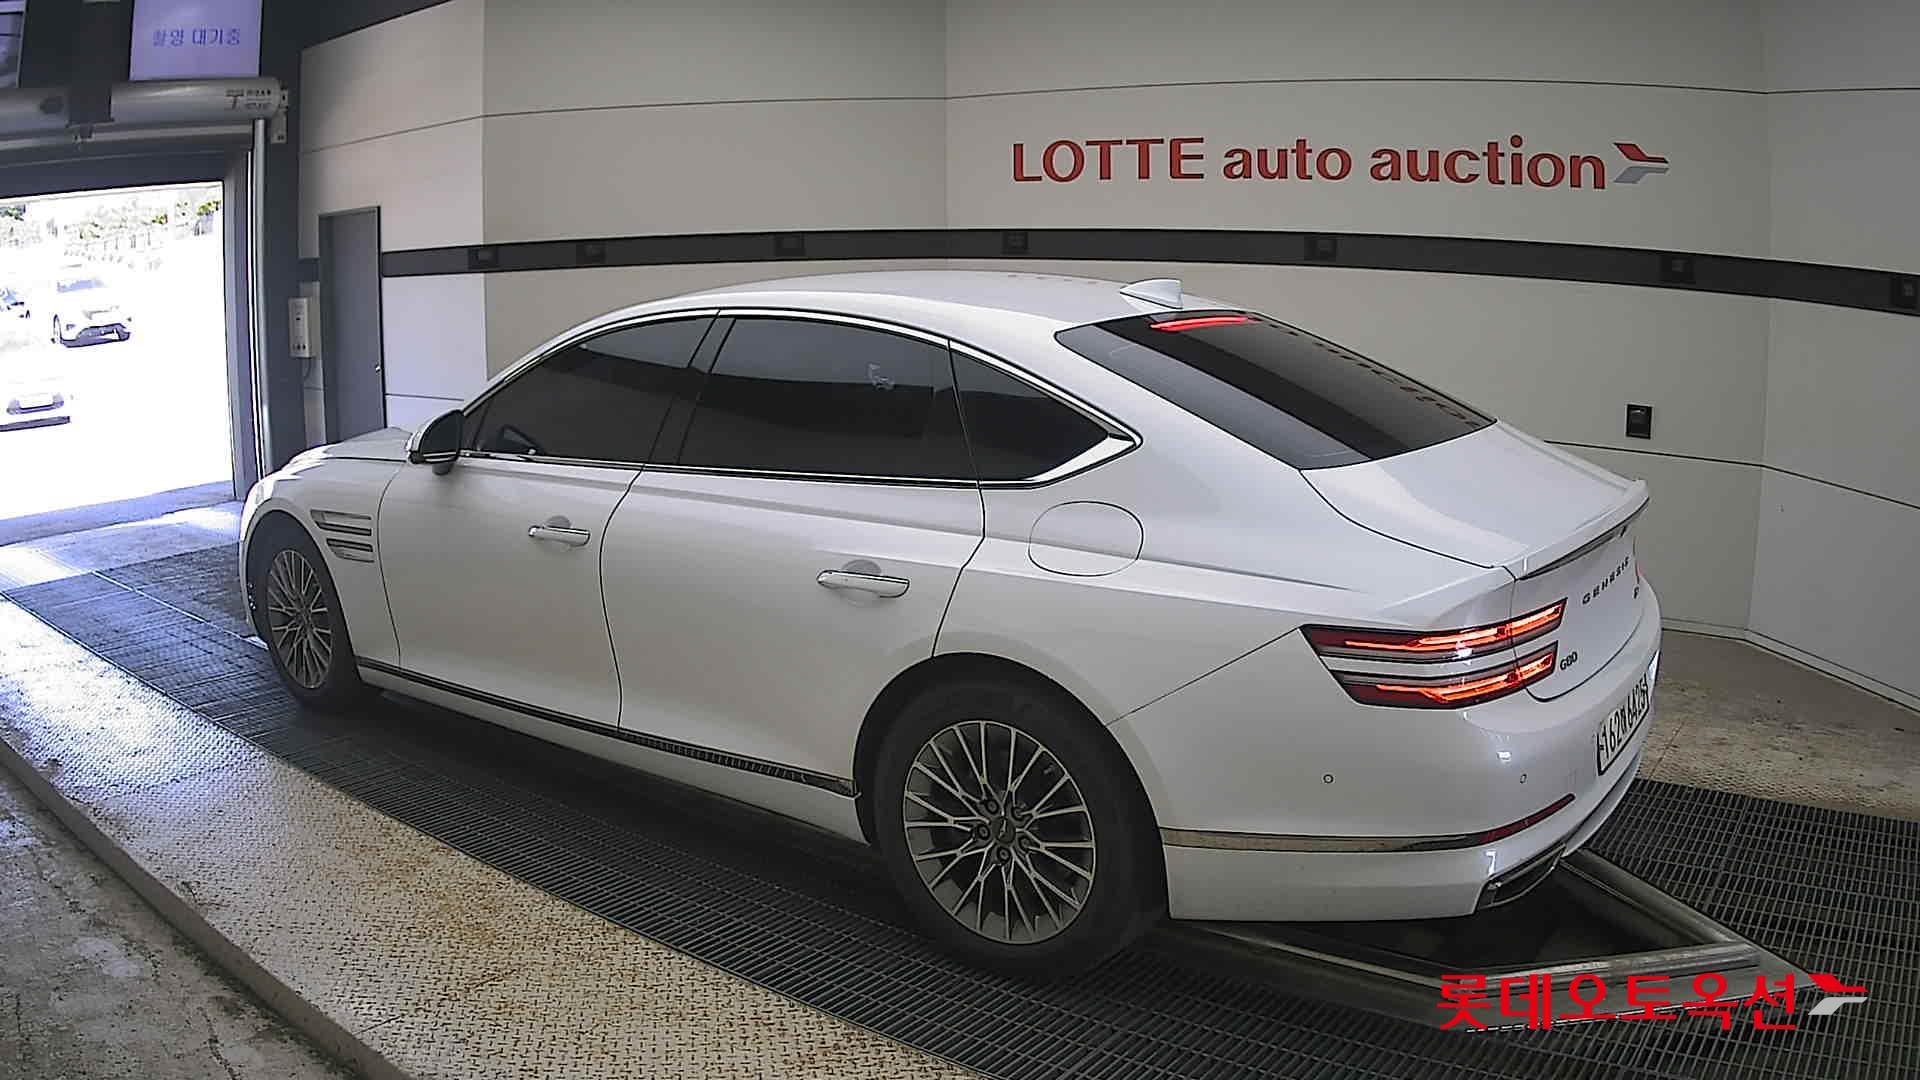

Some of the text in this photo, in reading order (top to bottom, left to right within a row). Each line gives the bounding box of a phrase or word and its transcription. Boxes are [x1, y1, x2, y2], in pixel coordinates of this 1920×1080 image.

[1012, 134, 1606, 190] LOTTE auto auction
